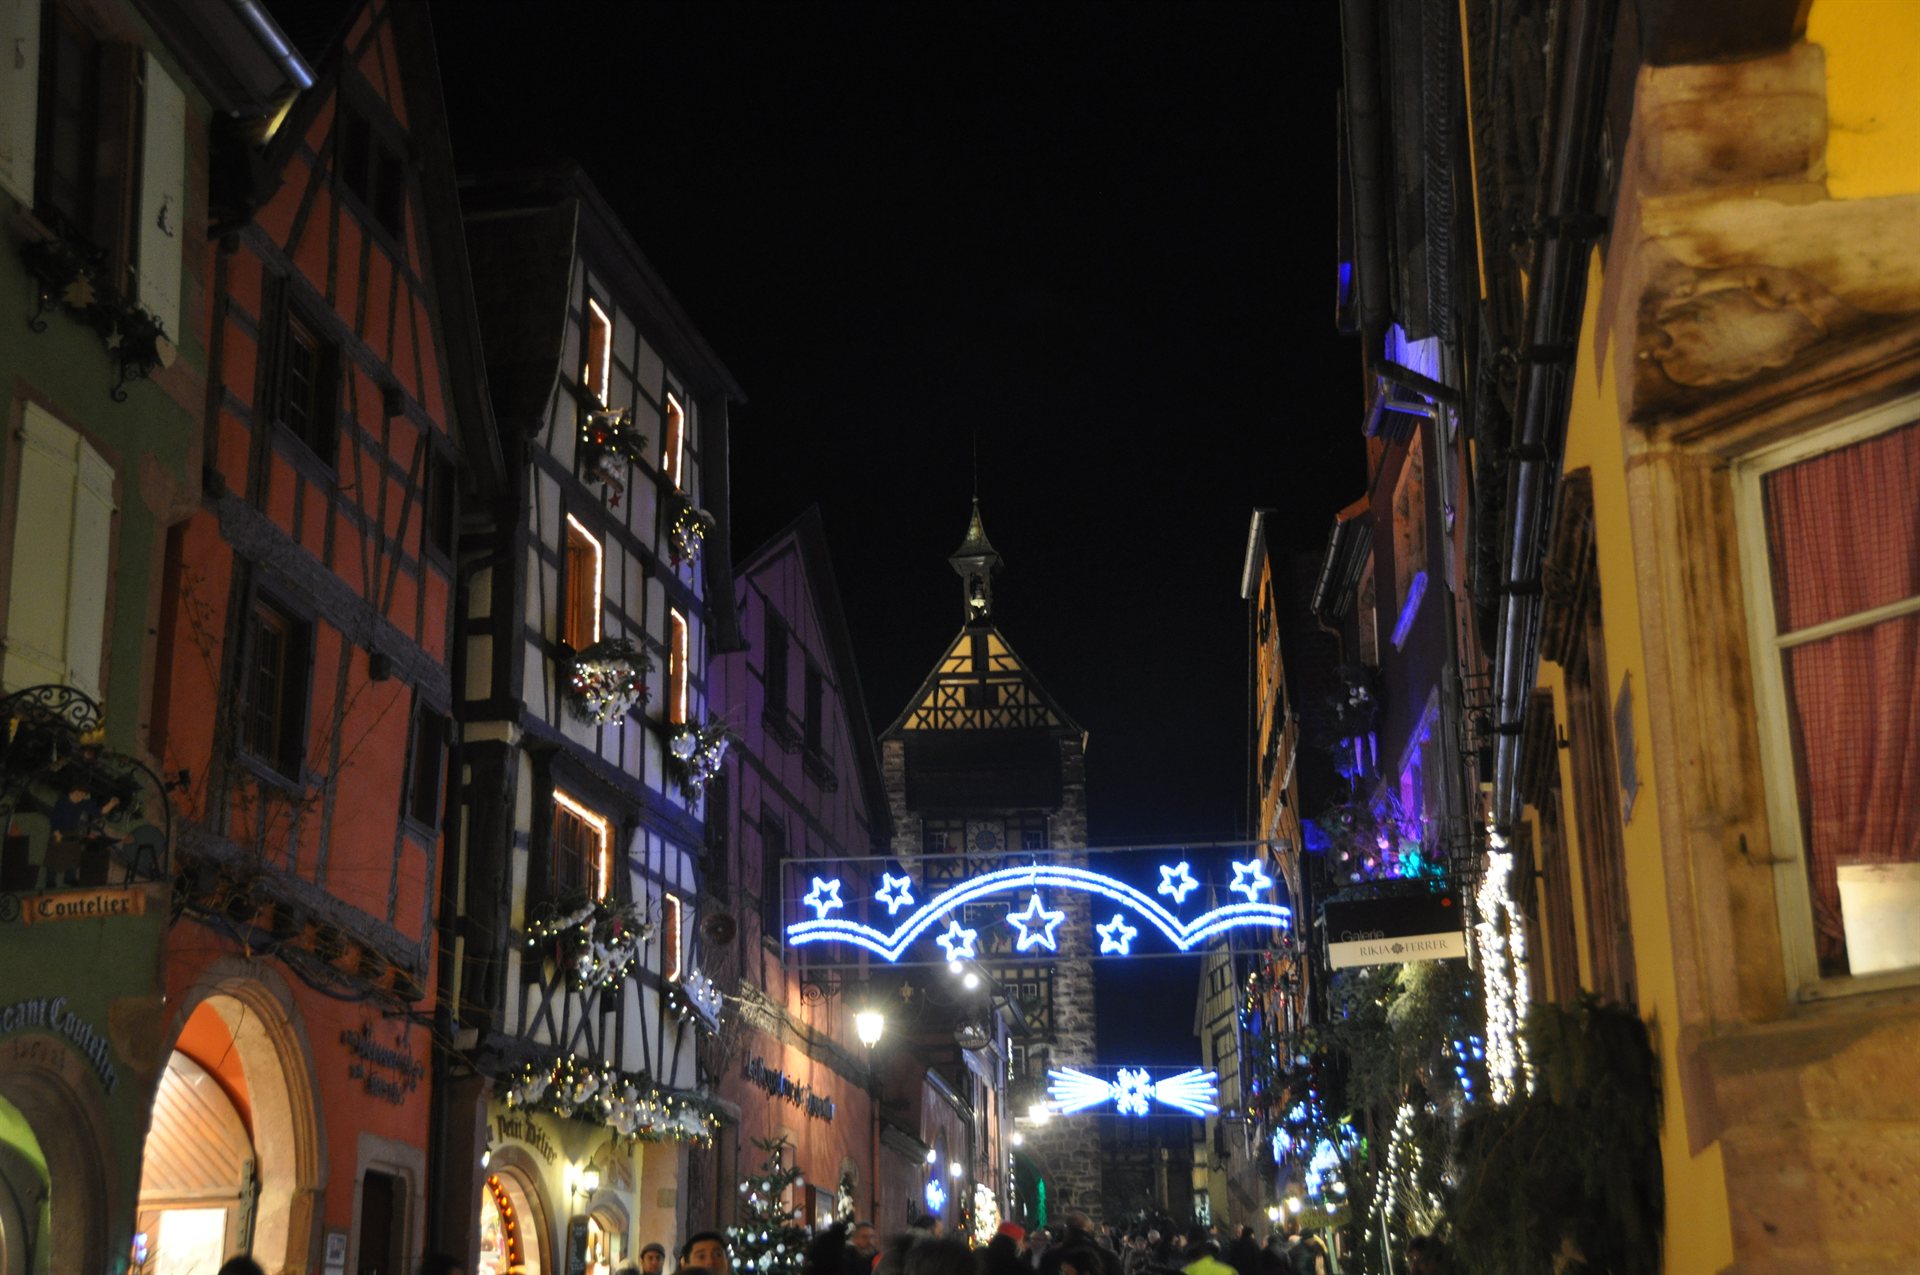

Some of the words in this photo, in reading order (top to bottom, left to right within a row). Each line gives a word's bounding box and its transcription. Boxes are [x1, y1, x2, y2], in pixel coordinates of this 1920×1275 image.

[38, 896, 130, 917] Coutelier
[1341, 929, 1385, 942] Galerie
[1360, 945, 1391, 957] RIKIA
[1405, 940, 1448, 953] FERRER
[49, 996, 119, 1095] Coutelier
